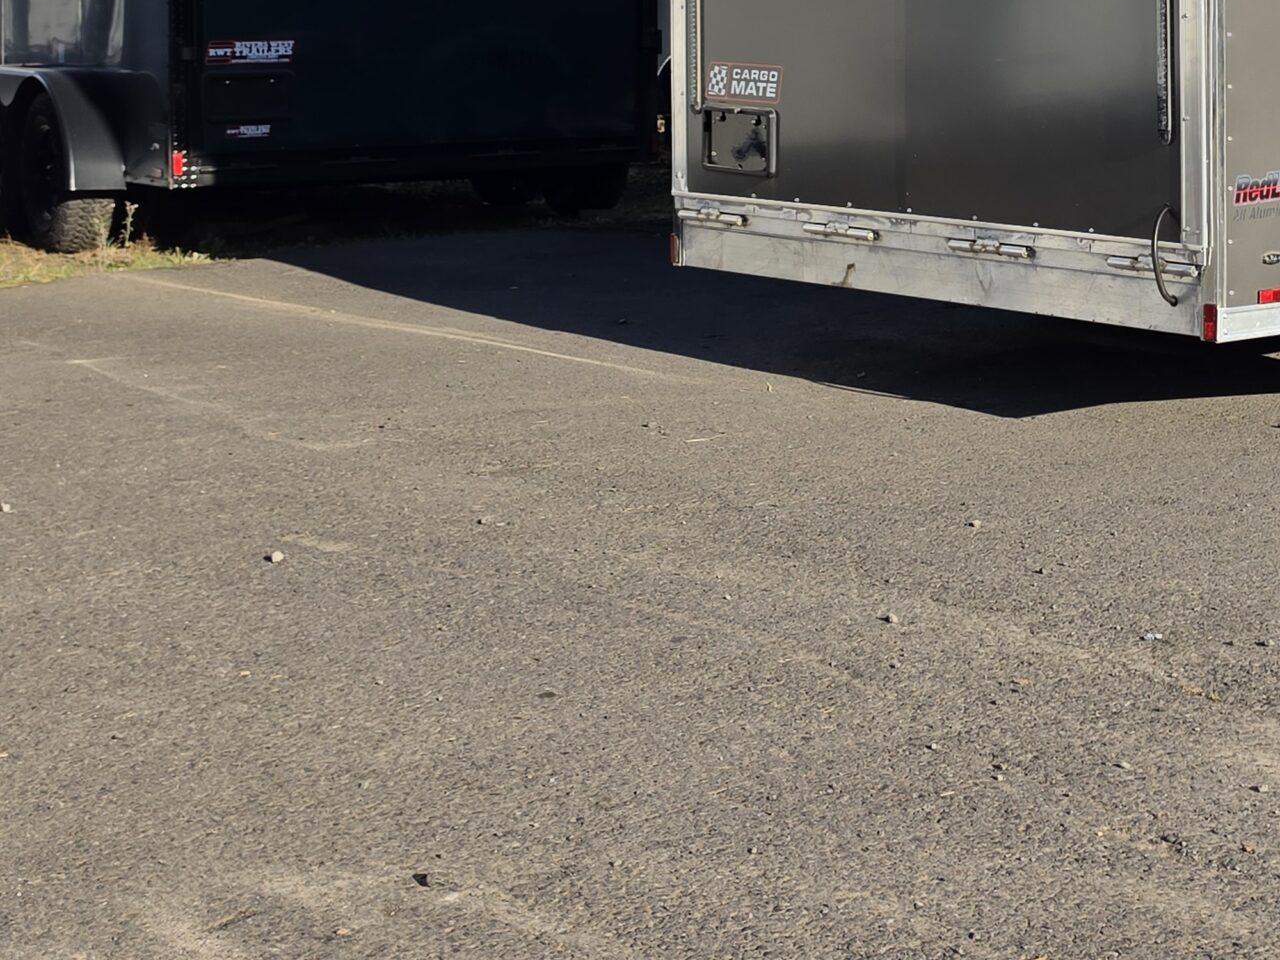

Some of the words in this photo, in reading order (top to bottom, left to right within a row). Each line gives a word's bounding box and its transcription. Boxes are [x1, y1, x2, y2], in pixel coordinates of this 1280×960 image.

[208, 48, 232, 56] RWT
[235, 47, 292, 56] TRAILERS
[732, 68, 778, 81] CARGO
[730, 80, 777, 97] MATE
